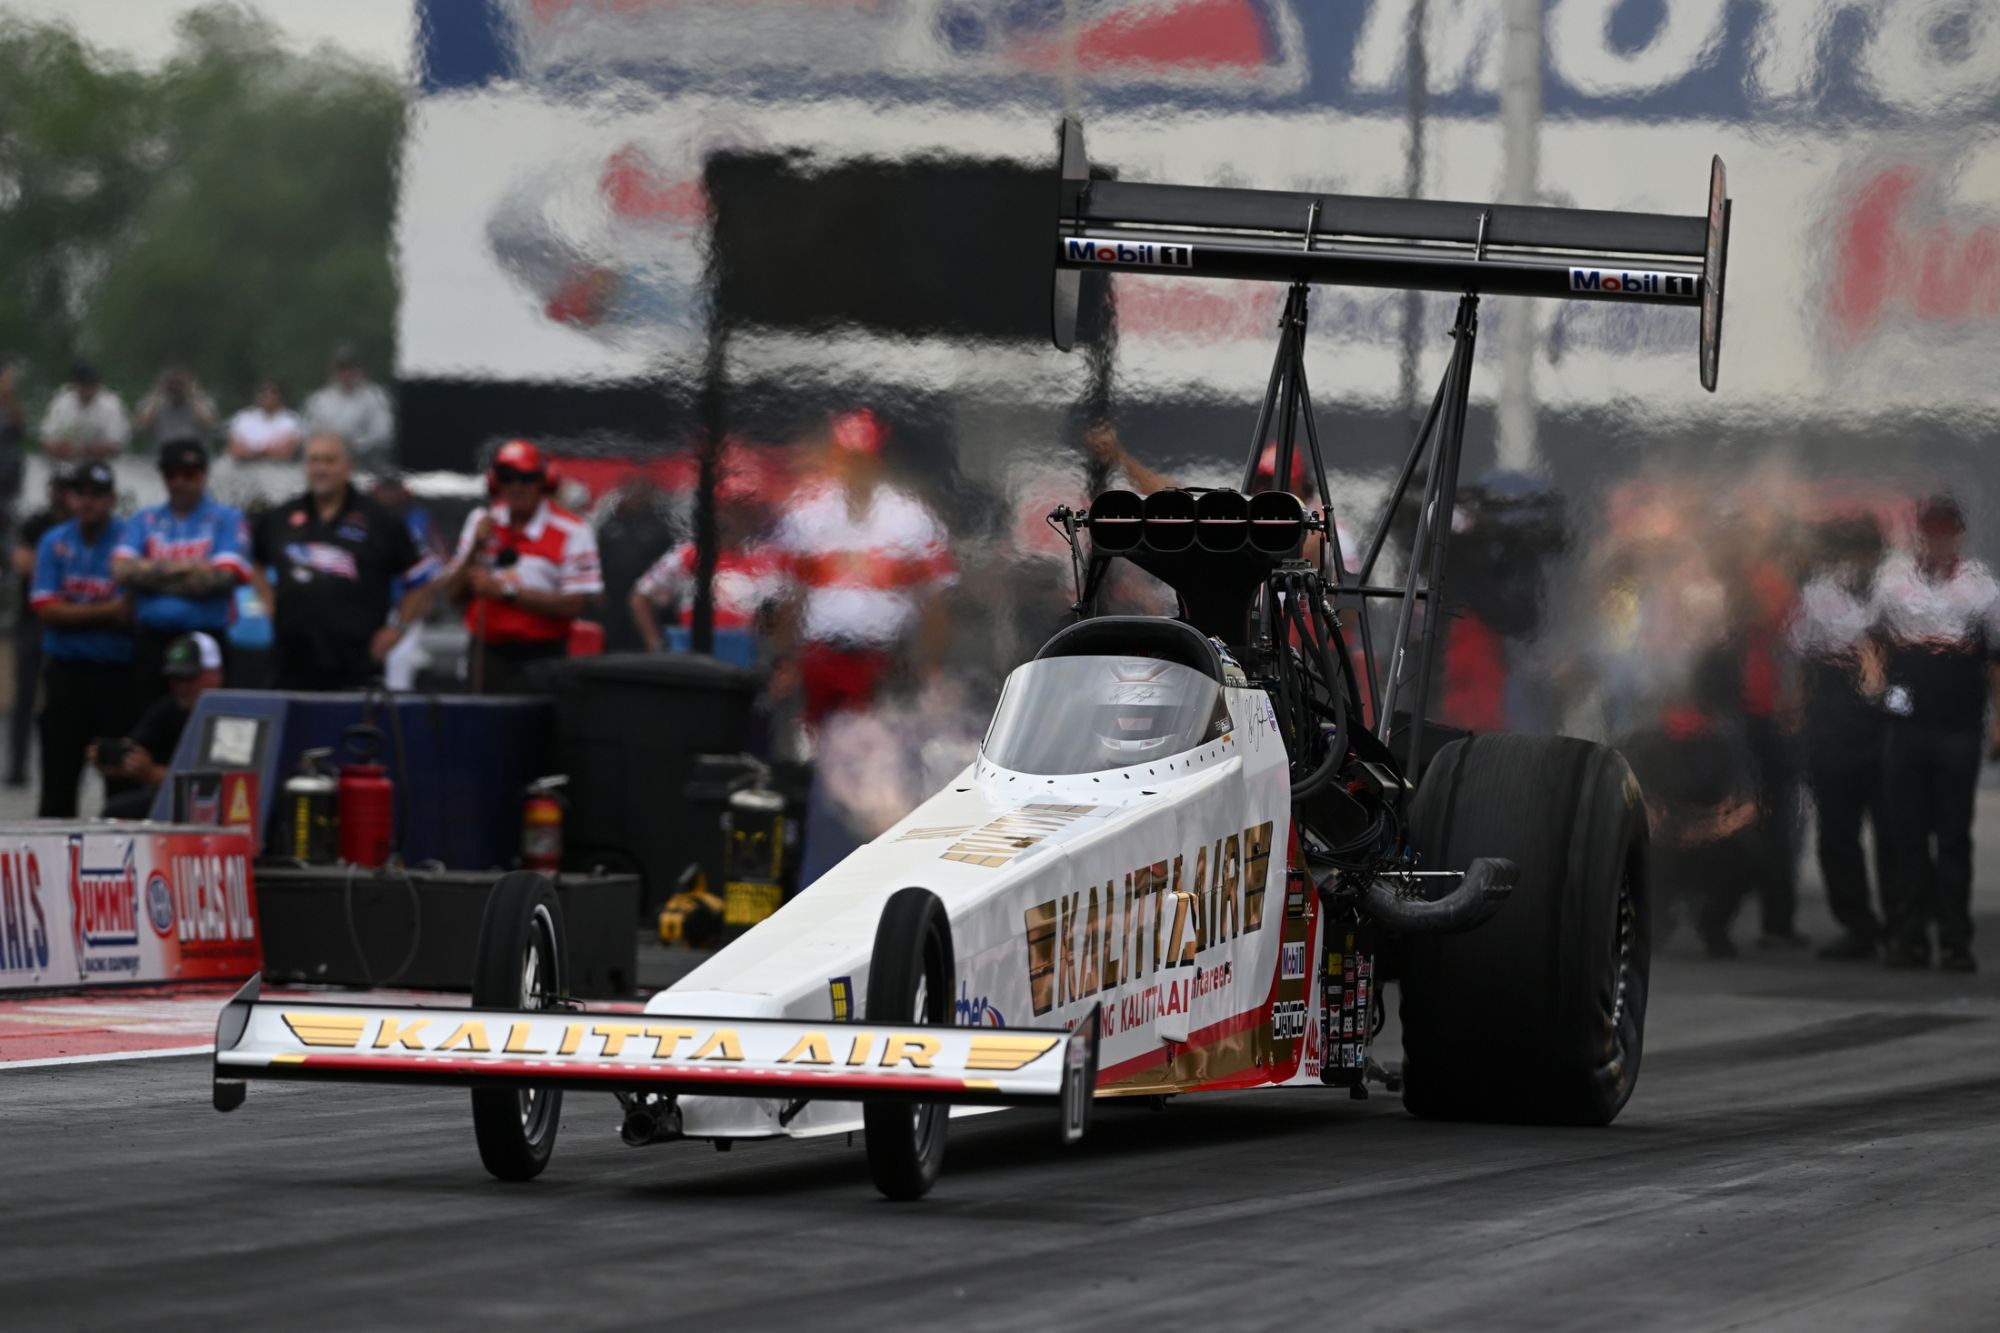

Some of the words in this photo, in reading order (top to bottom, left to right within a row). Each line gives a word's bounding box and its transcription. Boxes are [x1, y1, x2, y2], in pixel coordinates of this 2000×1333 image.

[1069, 240, 1154, 264] Mobil
[1573, 270, 1658, 293] Mobil
[171, 854, 226, 942] LUCAS
[225, 854, 255, 942] OIL
[1057, 853, 1196, 1008] KALITTA
[1194, 833, 1240, 954] AIR
[1283, 946, 1299, 975] Mobil
[1272, 1000, 1306, 1040] DAYCO
[372, 1016, 746, 1062] KALITTA
[776, 1031, 942, 1069] AIR
